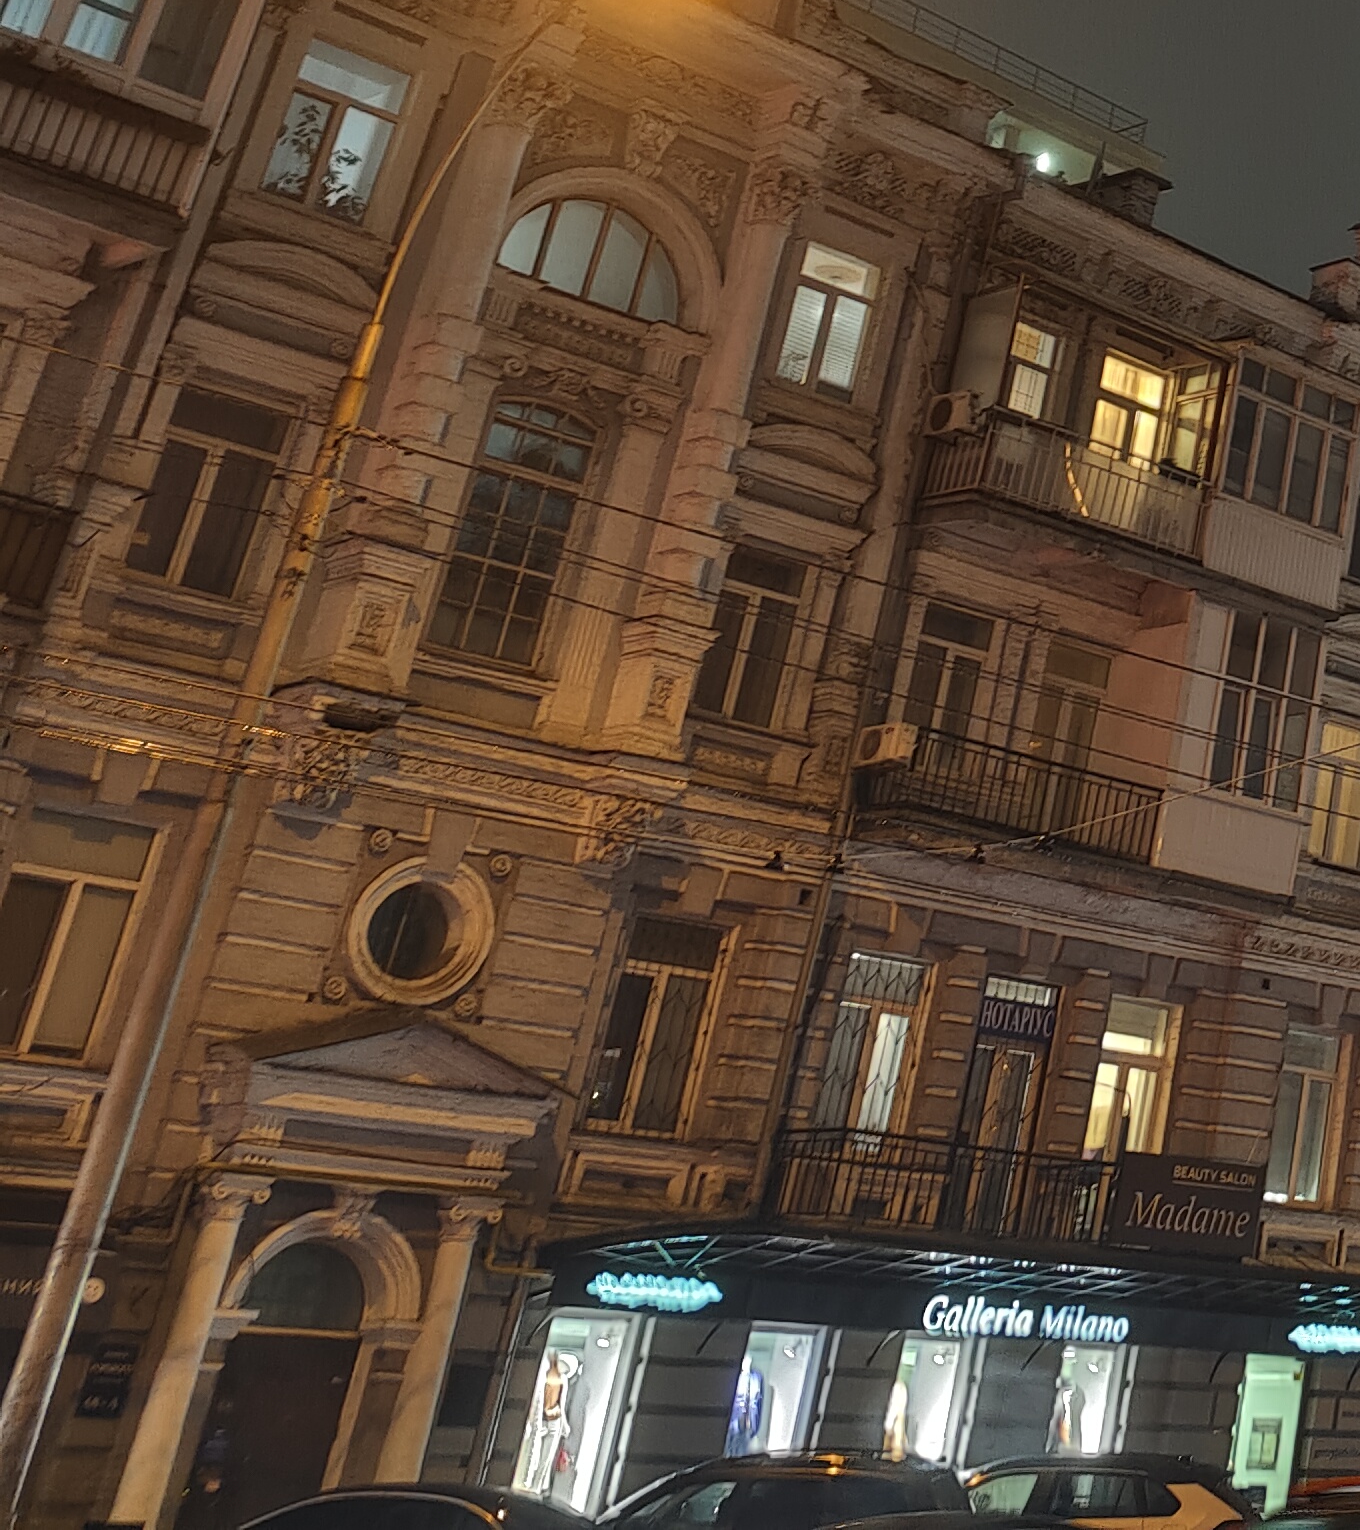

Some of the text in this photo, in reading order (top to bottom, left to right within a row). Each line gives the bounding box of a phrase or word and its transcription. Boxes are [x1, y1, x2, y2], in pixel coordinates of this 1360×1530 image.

[980, 1000, 1055, 1037] НОТАРІУС
[1173, 1164, 1257, 1187] BEAUTY SALON
[1124, 1191, 1251, 1238] Madame
[922, 1293, 1129, 1343] Galleria Milano
